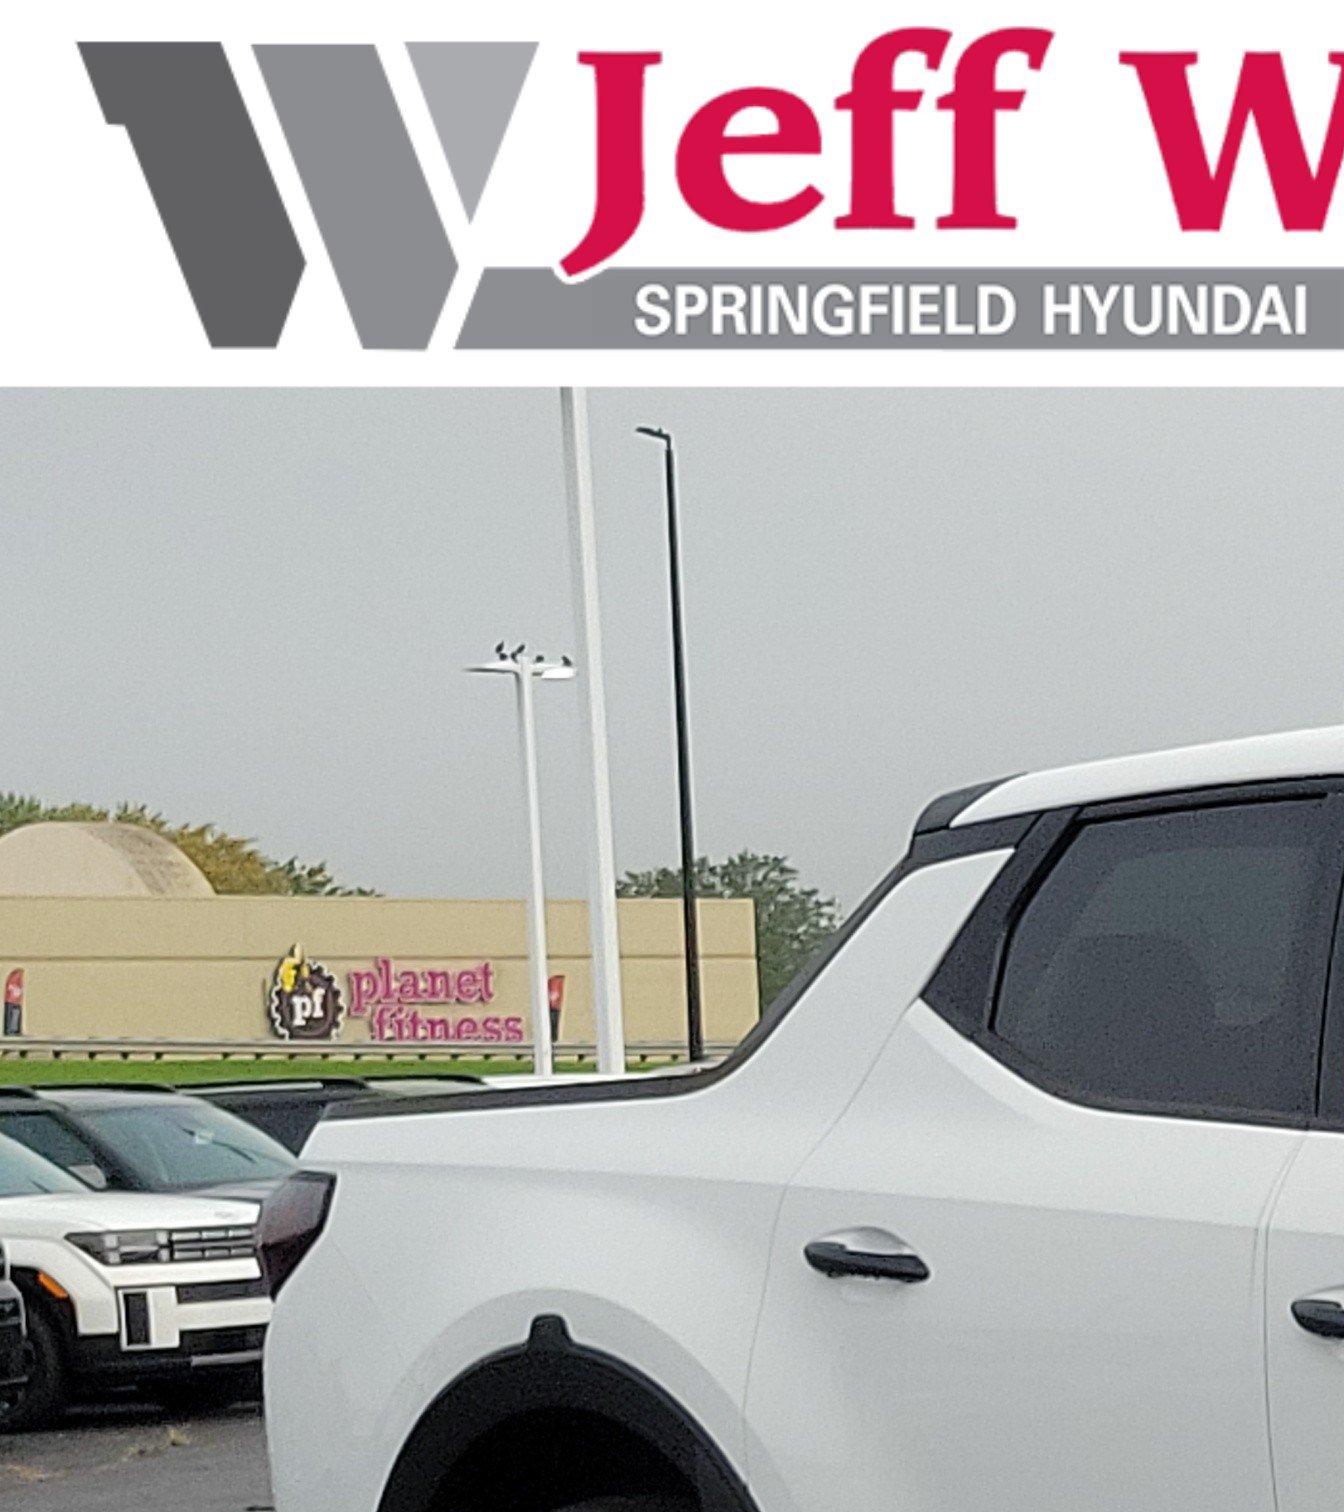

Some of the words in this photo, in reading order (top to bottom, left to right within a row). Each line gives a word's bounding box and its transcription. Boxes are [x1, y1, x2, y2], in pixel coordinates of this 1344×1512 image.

[351, 957, 494, 1016] planet
[290, 988, 326, 1027] pf
[371, 1003, 524, 1041] fitness
